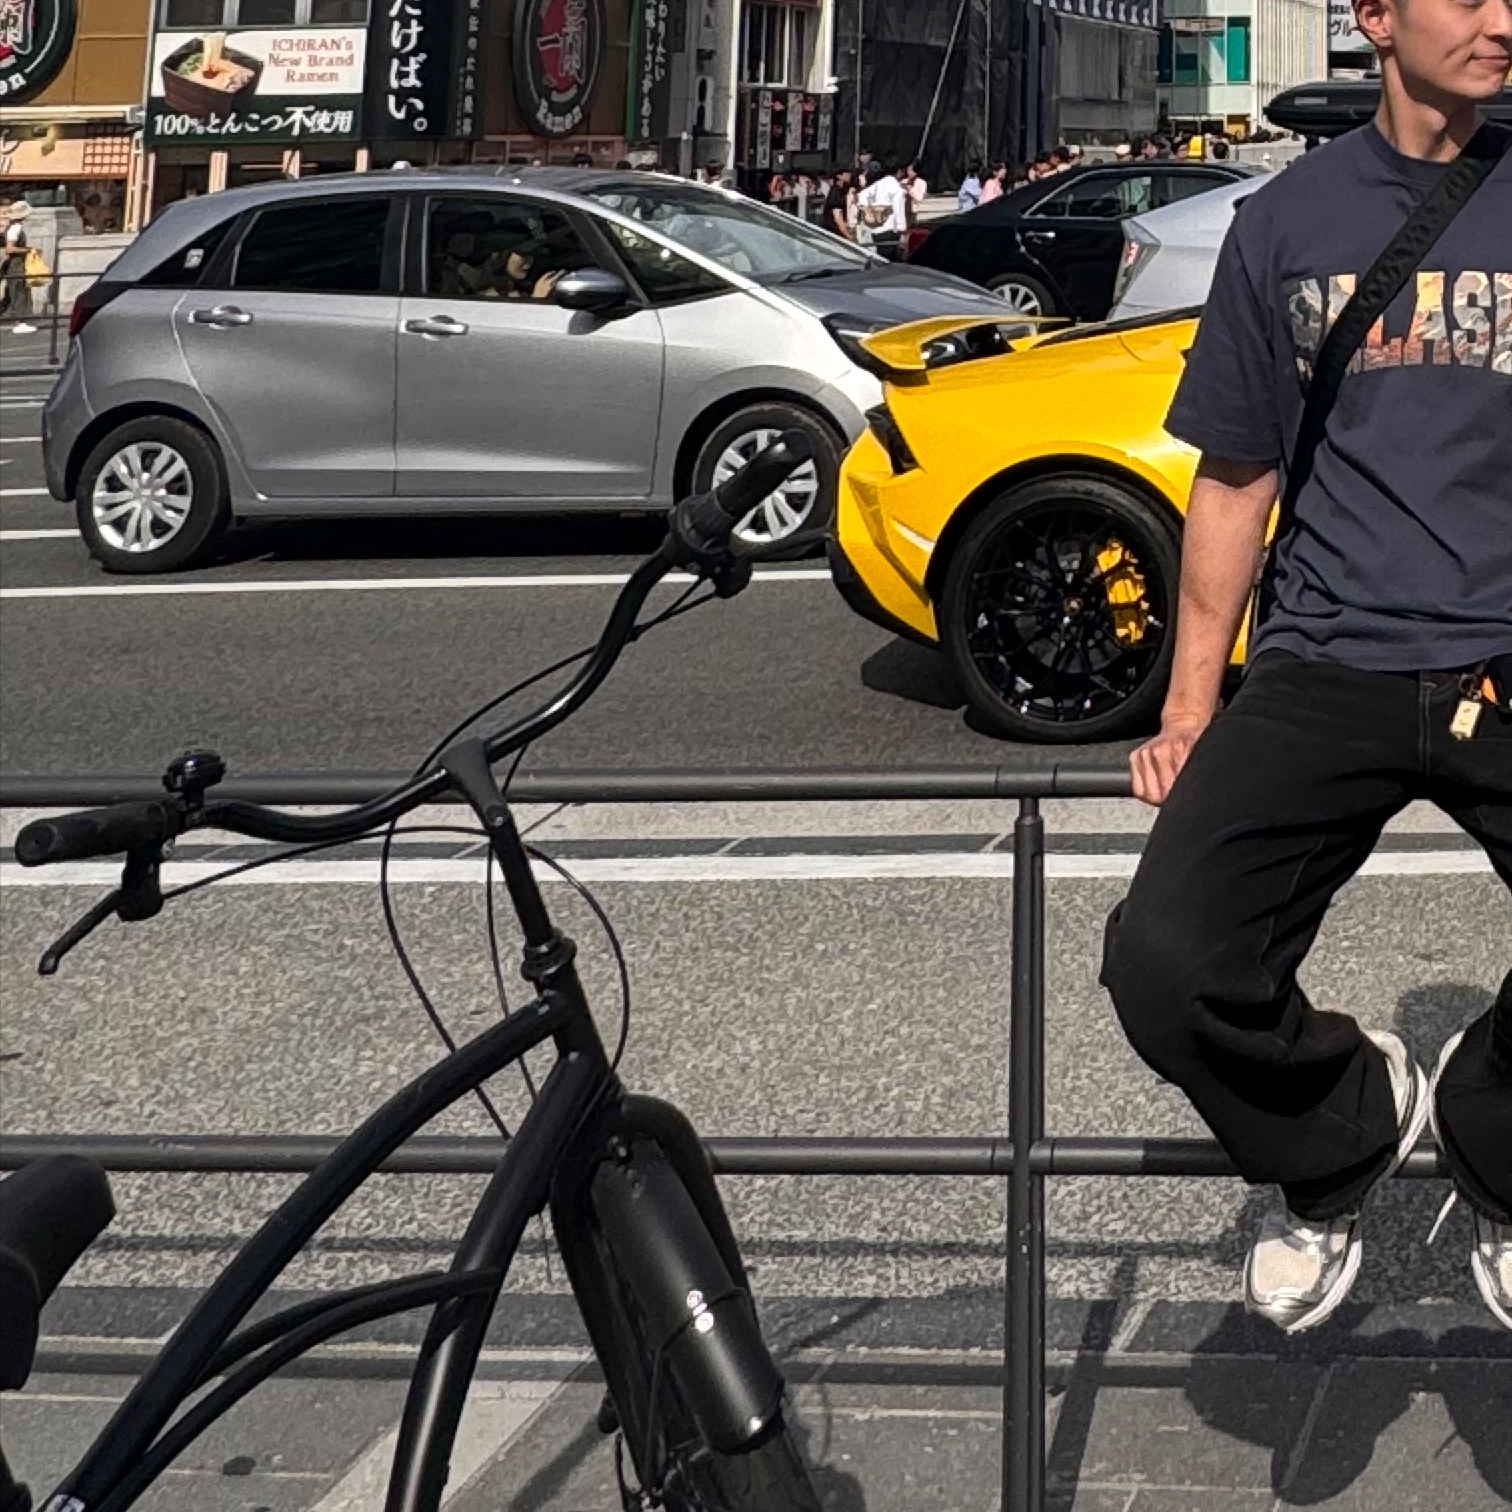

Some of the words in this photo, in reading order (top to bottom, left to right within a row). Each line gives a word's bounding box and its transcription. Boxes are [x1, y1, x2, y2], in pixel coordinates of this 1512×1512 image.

[272, 35, 354, 53] ICHIRAN's
[268, 53, 302, 67] New
[306, 53, 355, 67] Brand
[285, 69, 340, 83] Ramen
[536, 97, 583, 134] Ramen
